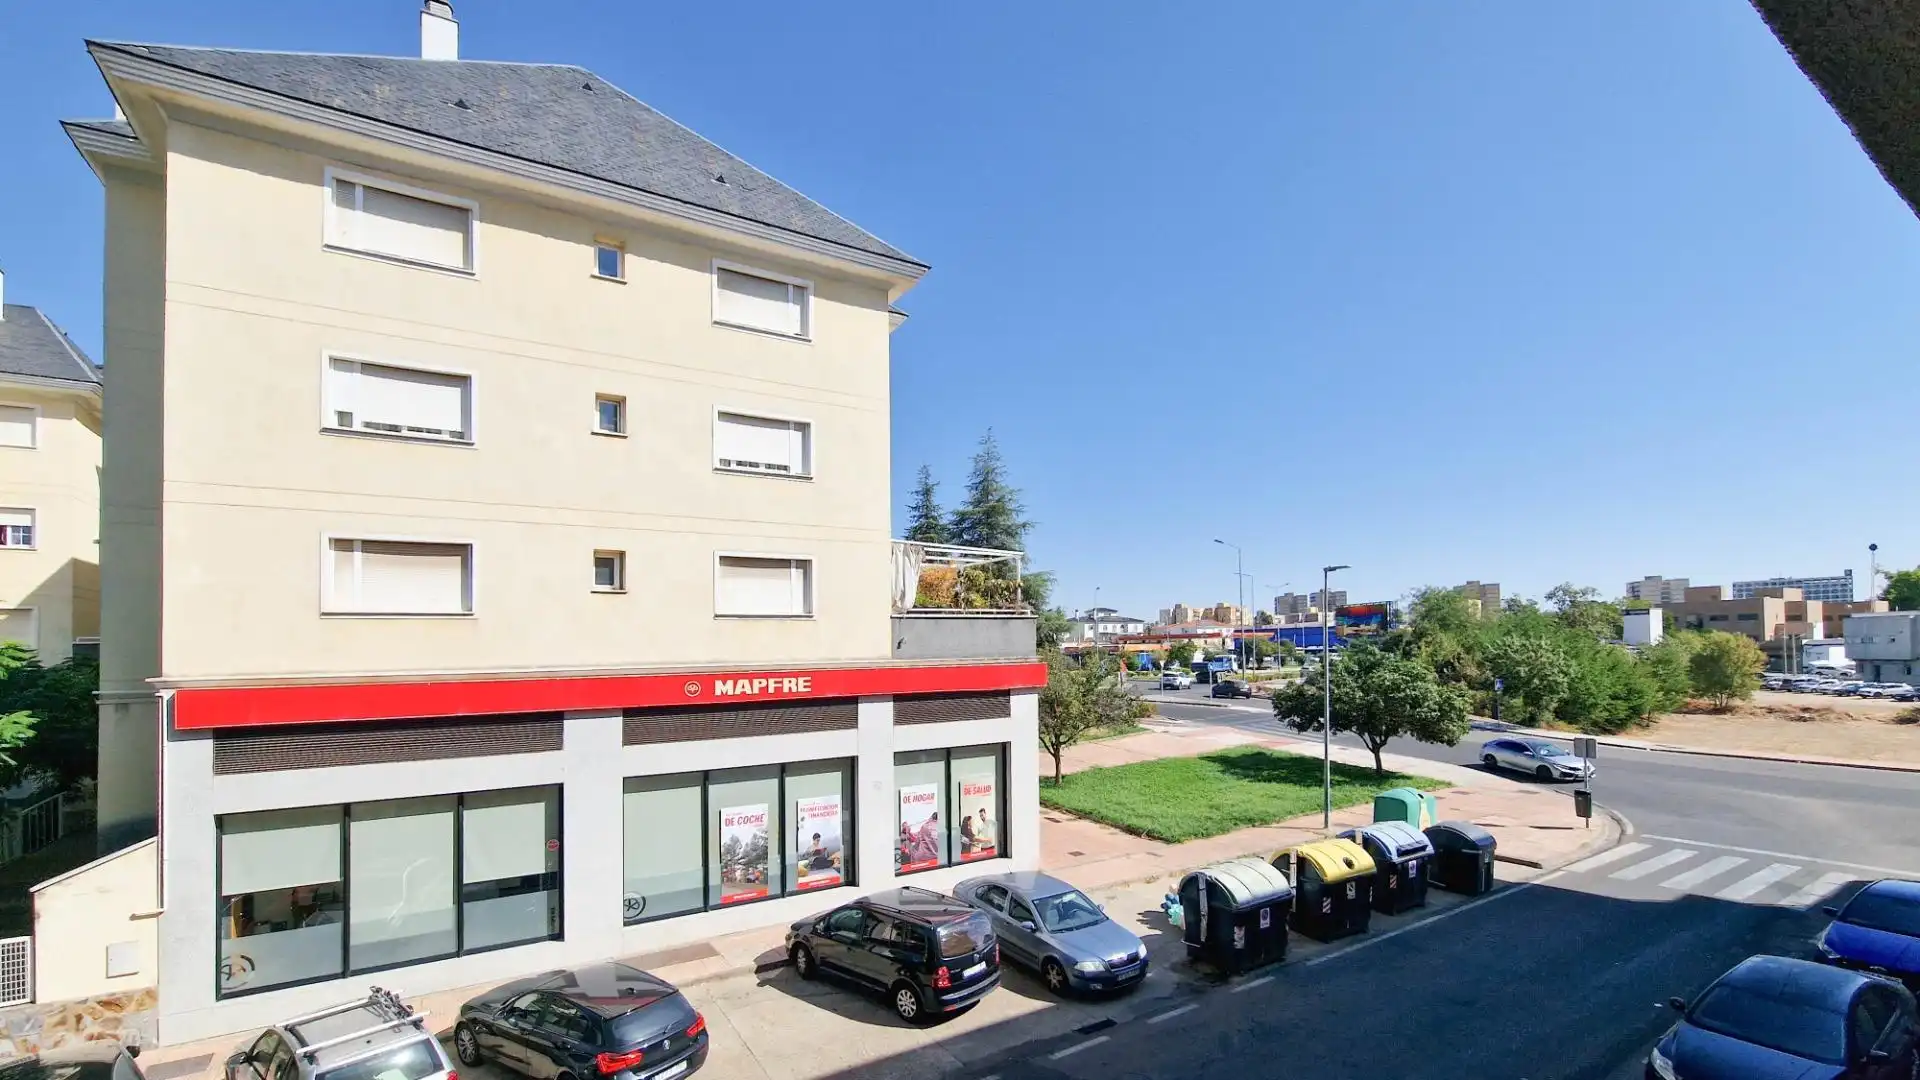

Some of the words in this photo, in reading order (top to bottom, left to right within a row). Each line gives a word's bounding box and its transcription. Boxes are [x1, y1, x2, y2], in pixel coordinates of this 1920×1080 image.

[714, 676, 812, 696] MAPFRE
[912, 792, 935, 803] HOGAR
[724, 817, 735, 827] DE
[737, 813, 765, 825] COCHE
